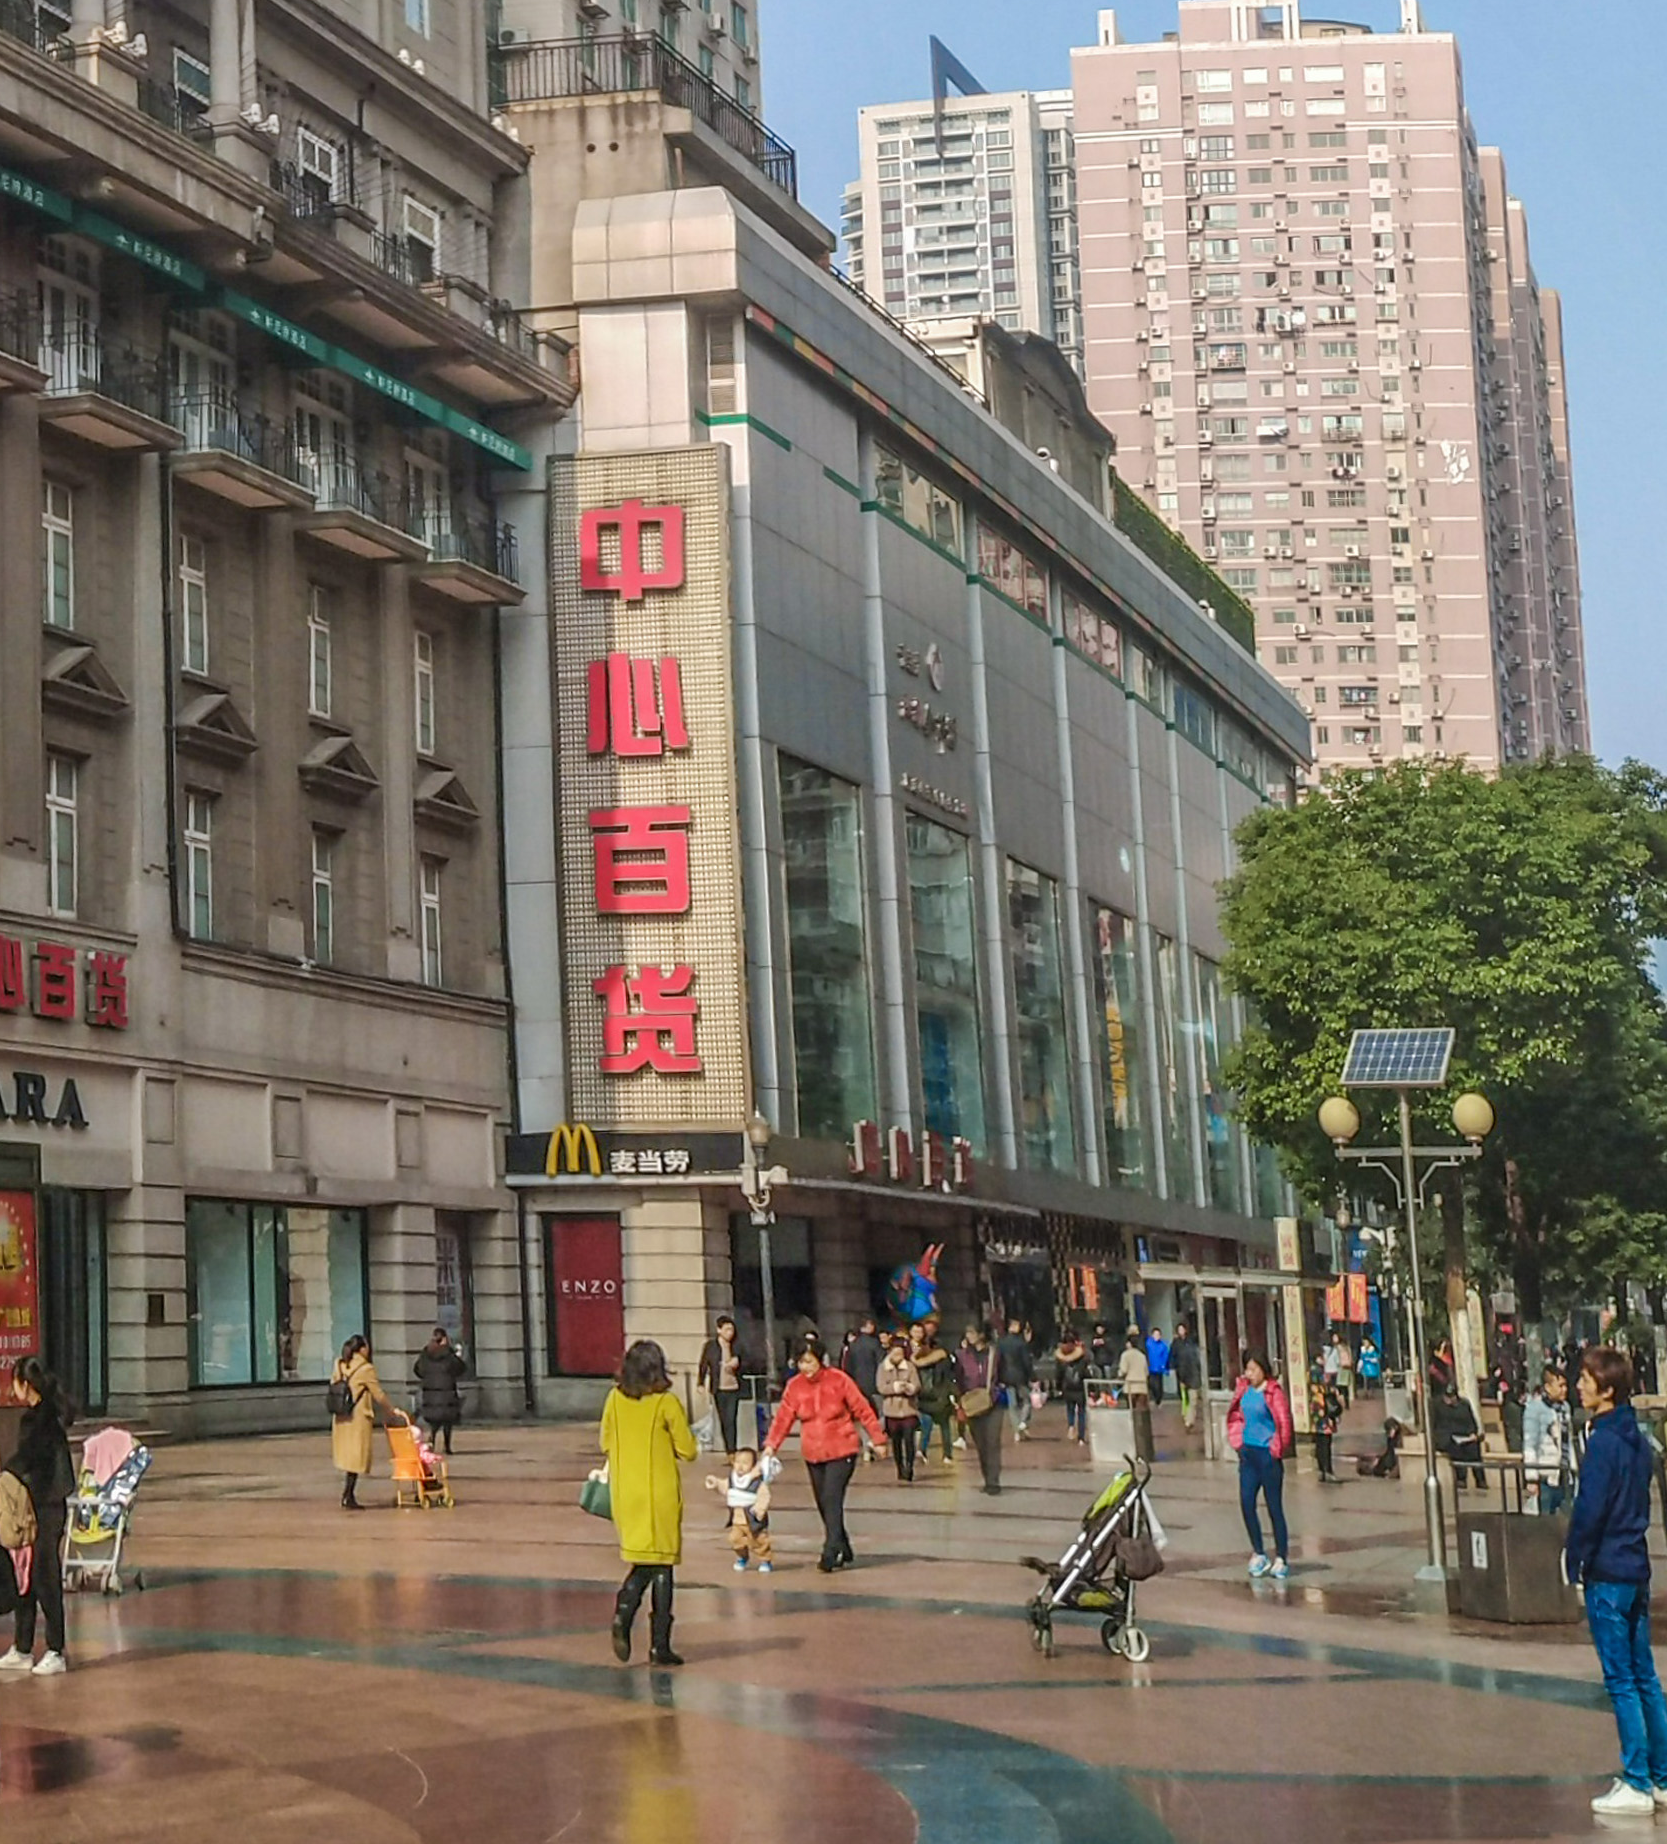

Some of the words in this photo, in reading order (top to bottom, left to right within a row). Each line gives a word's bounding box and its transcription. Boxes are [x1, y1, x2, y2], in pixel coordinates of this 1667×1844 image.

[579, 497, 702, 1074] 中心百货
[610, 1150, 690, 1174] 麦当劳
[562, 1280, 616, 1294] ENZO
